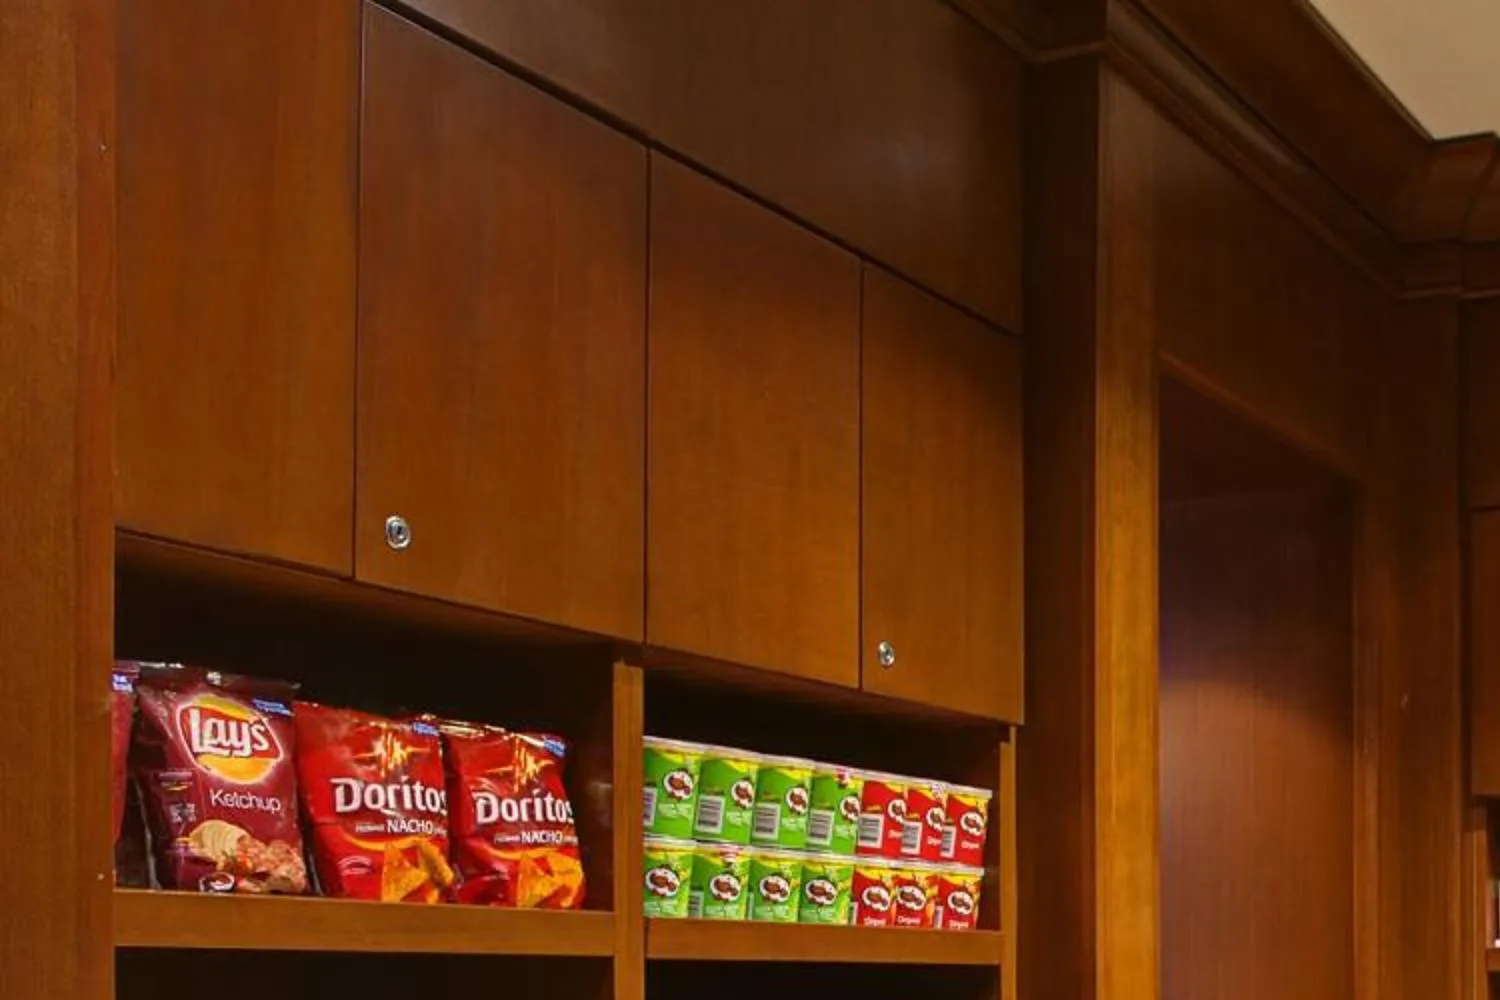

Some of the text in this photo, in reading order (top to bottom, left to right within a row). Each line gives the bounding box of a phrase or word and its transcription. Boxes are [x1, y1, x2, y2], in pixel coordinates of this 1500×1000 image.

[188, 707, 270, 757] Lay's
[210, 787, 282, 815] Ketchup
[387, 819, 433, 834] NACHO
[521, 830, 563, 844] NACHO
